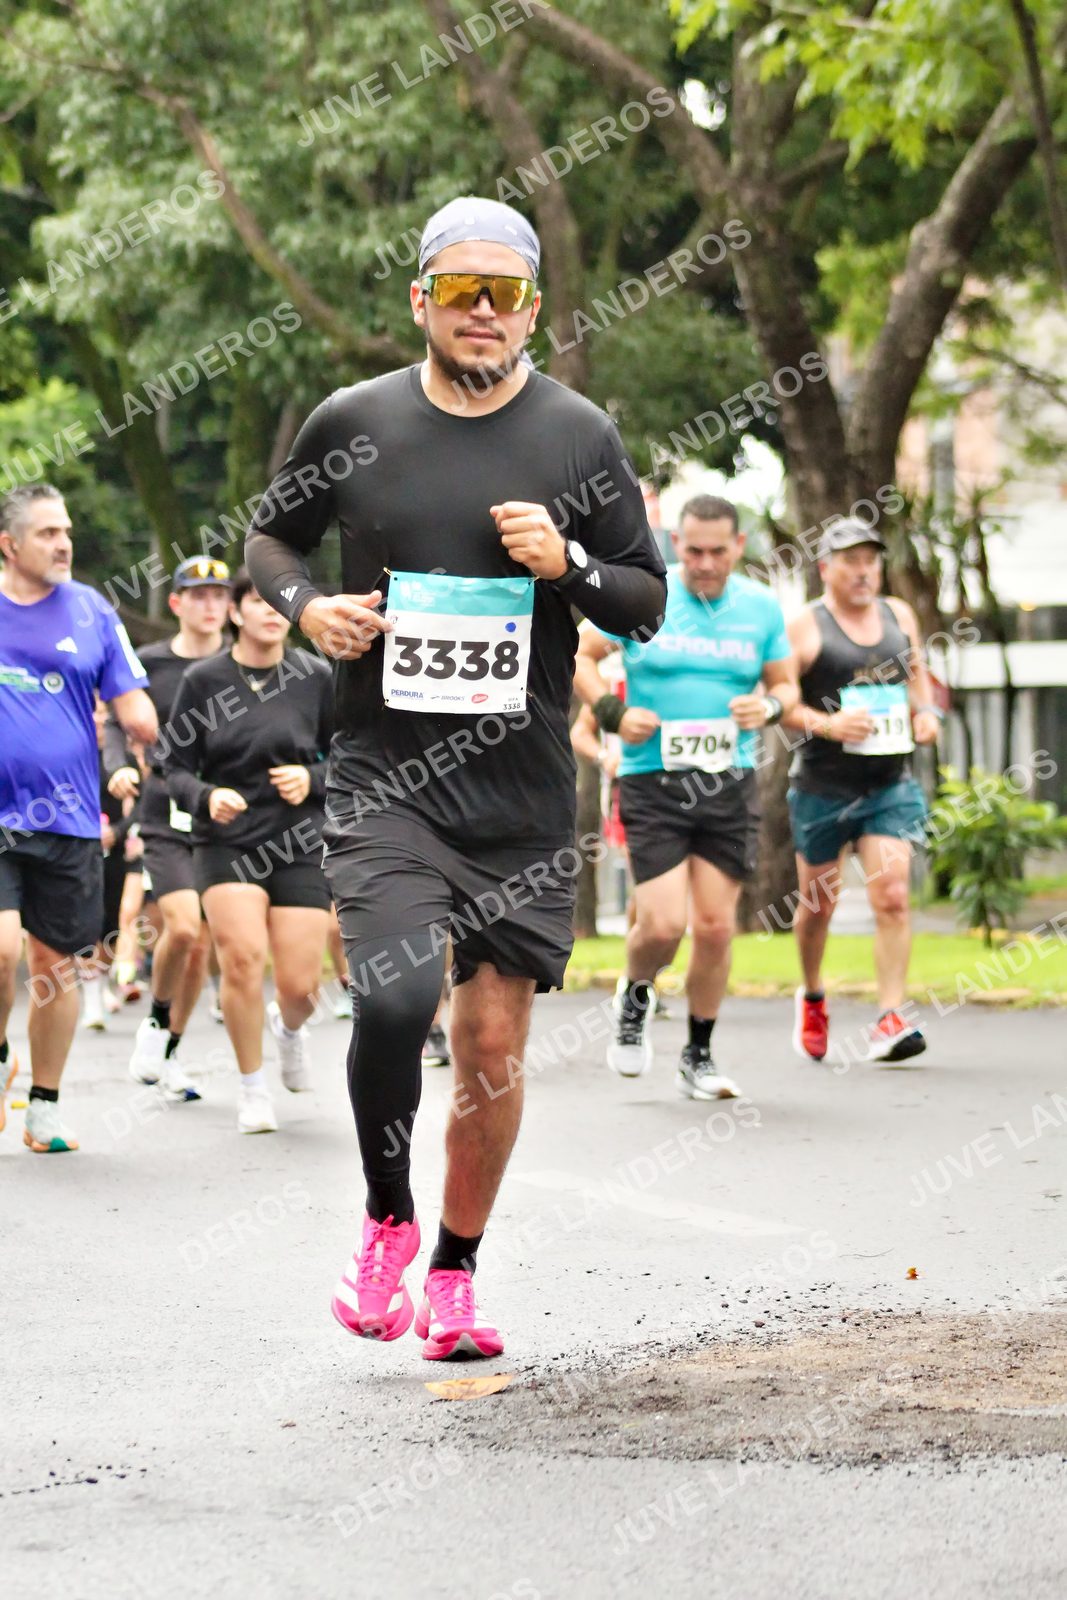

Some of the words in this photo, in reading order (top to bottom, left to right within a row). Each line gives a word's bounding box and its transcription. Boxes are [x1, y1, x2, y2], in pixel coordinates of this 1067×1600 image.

[392, 636, 520, 681] 3338
[391, 689, 424, 699] PERDURA
[502, 702, 521, 711] 3338
[669, 734, 731, 756] 5704
